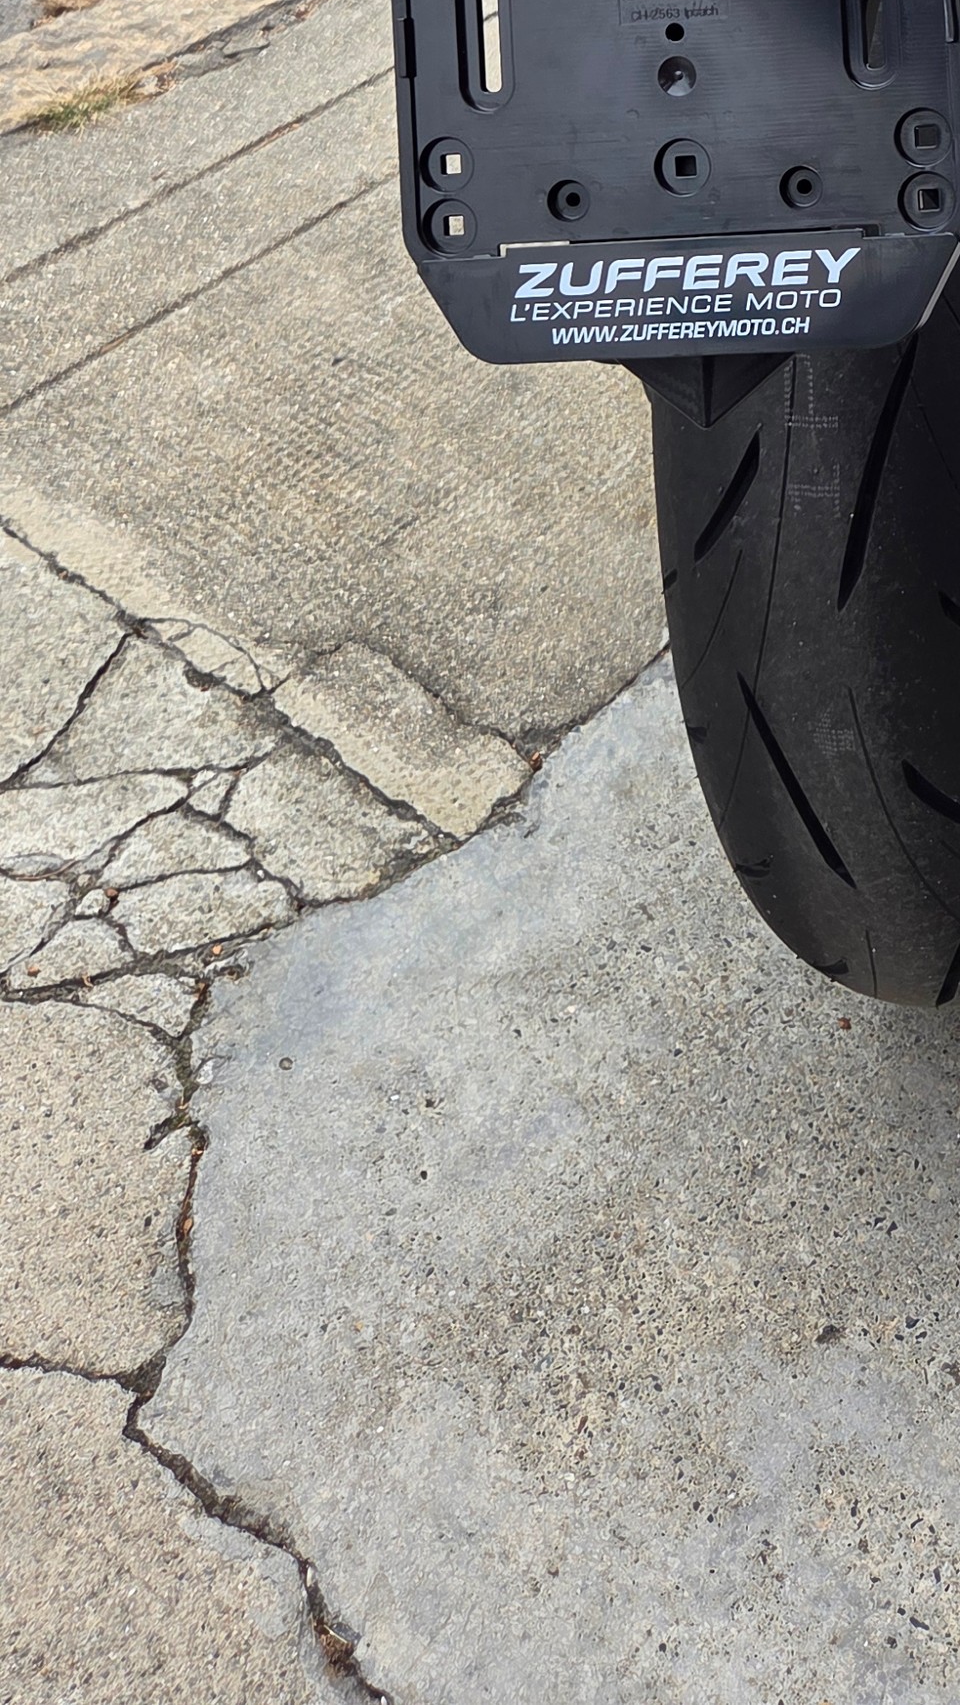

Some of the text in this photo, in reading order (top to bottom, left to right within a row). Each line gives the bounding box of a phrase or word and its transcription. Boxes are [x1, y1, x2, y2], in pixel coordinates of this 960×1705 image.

[514, 247, 861, 299] ZUFFEREY
[510, 288, 842, 323] L'EXPERIENCE MOTO
[552, 317, 811, 345] WWW.ZUFFEREYMOTO.CH
